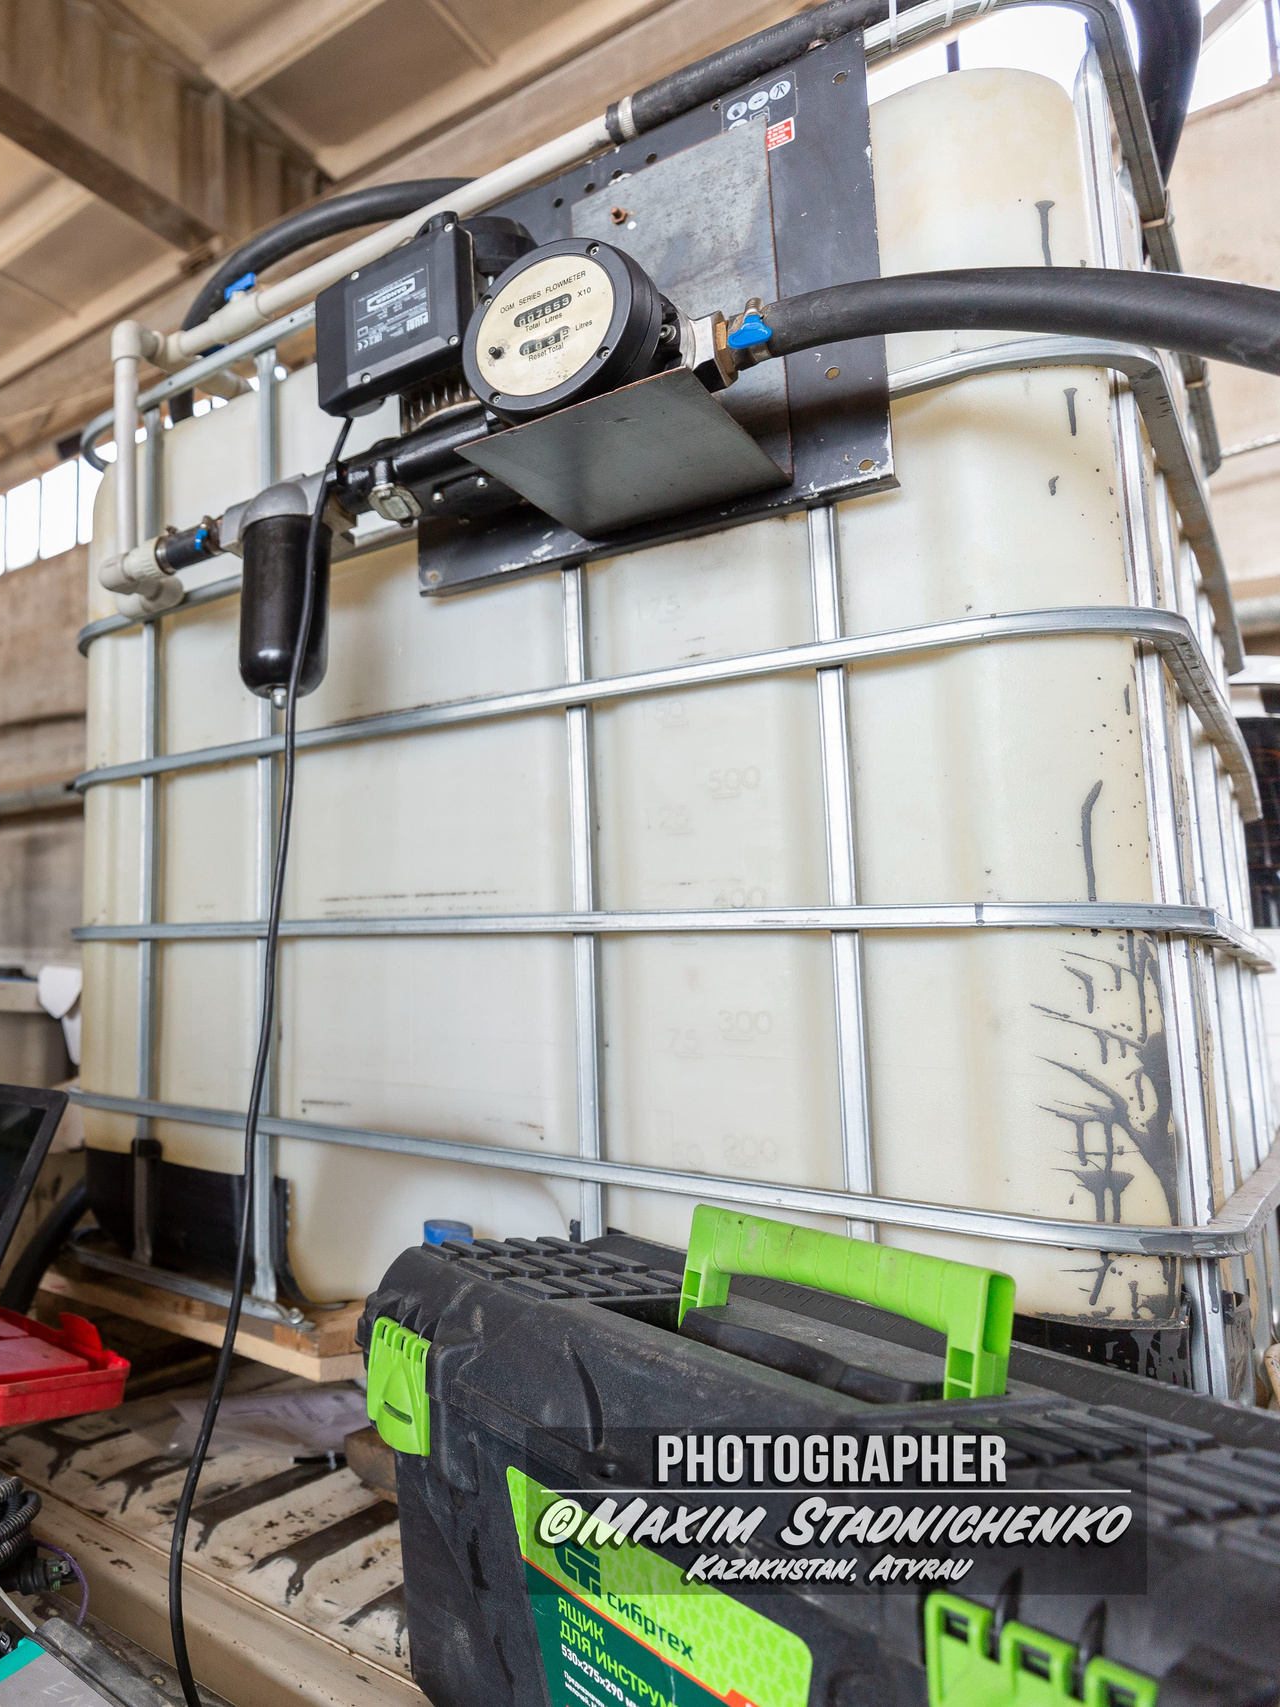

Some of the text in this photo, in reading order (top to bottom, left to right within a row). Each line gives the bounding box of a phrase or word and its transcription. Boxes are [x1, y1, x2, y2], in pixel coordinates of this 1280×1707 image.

[500, 270, 587, 314] OGM SERIES FLOWMETER
[525, 312, 563, 333] Total Litres
[575, 319, 593, 332] Litres
[528, 342, 564, 362] Reset Total
[707, 765, 761, 793] 500
[717, 1010, 772, 1035] 300
[722, 1133, 778, 1163] 200
[558, 1597, 605, 1646] ЯЩИК
[607, 1591, 694, 1662] сибртех
[560, 1620, 592, 1658] ДЛЯ
